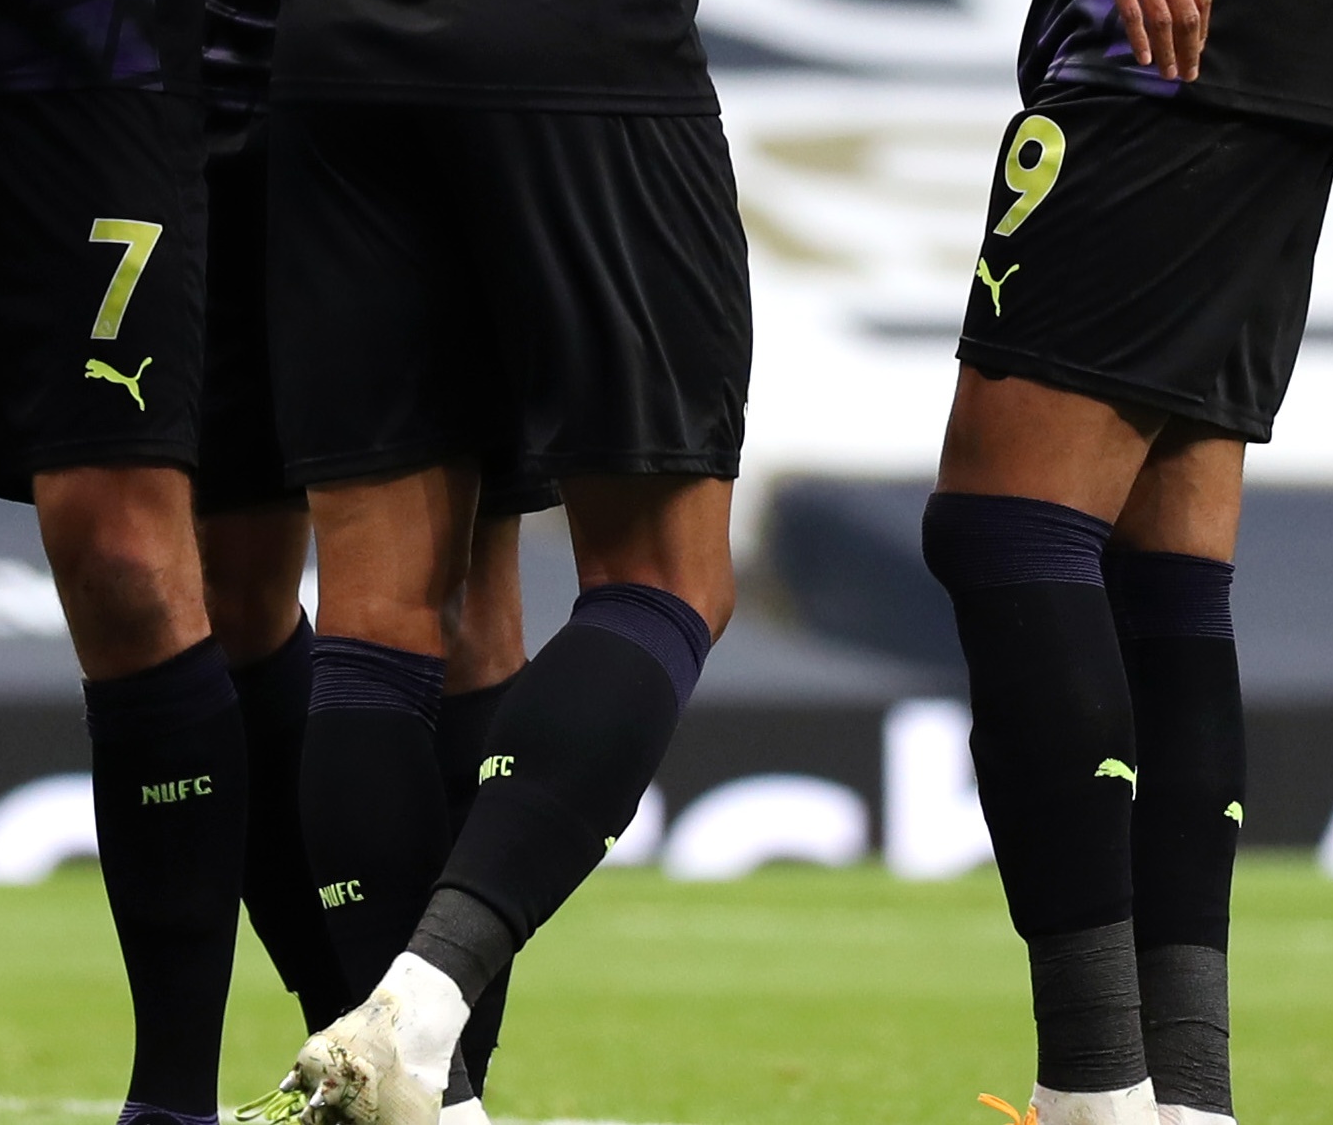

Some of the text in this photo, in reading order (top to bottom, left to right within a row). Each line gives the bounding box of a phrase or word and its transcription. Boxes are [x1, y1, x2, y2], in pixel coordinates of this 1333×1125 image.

[993, 114, 1066, 237] 9
[88, 218, 163, 340] 7
[141, 775, 212, 805] NUFC
[318, 879, 365, 910] NUFC
